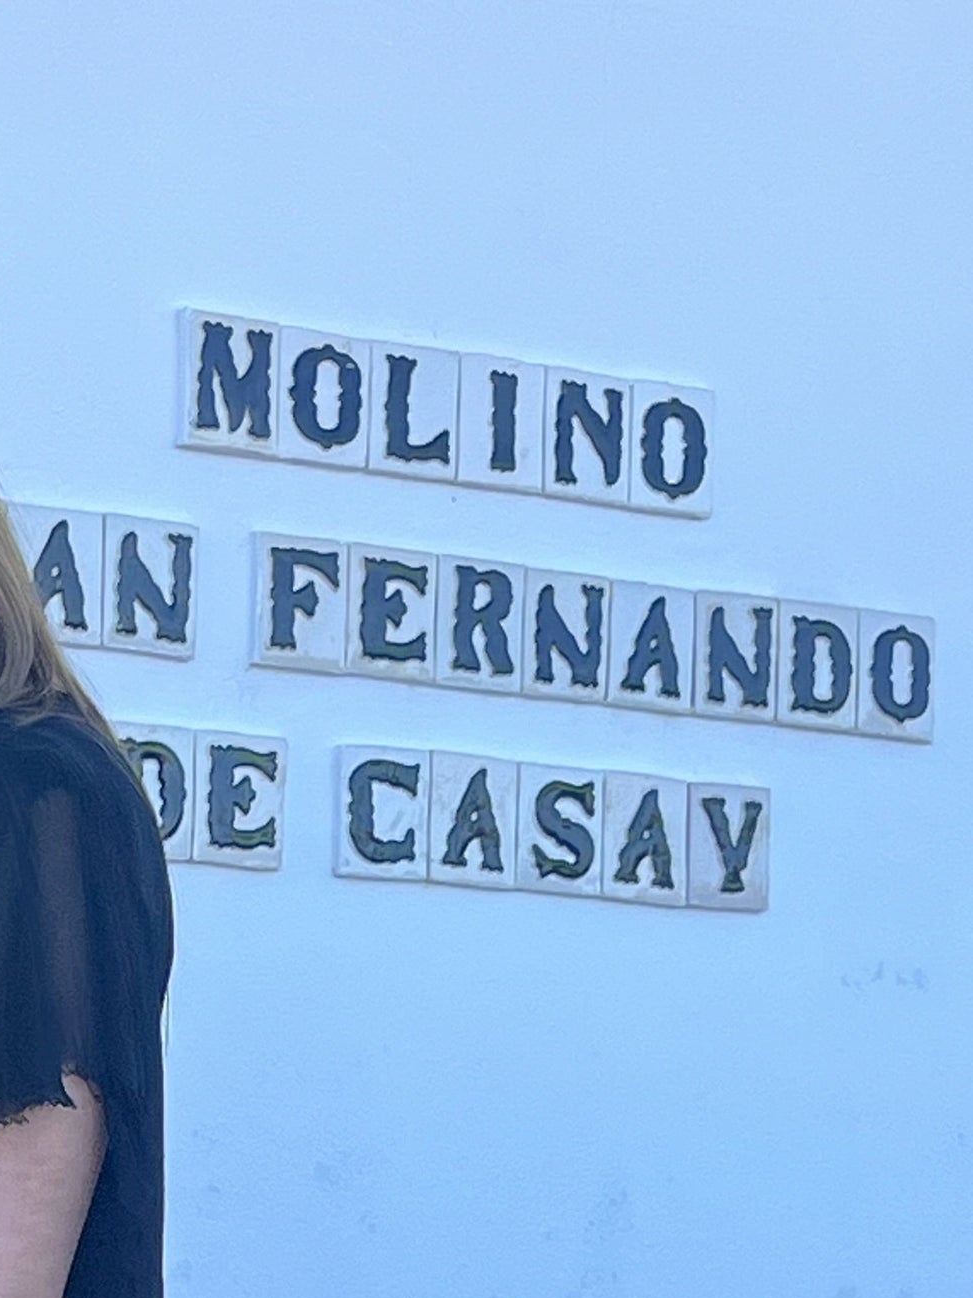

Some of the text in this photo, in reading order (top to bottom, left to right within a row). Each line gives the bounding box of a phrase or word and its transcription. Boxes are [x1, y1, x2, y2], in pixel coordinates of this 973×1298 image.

[194, 320, 708, 500] MOLINO
[270, 546, 931, 724] FERNANDO
[347, 758, 763, 894] CASAY
